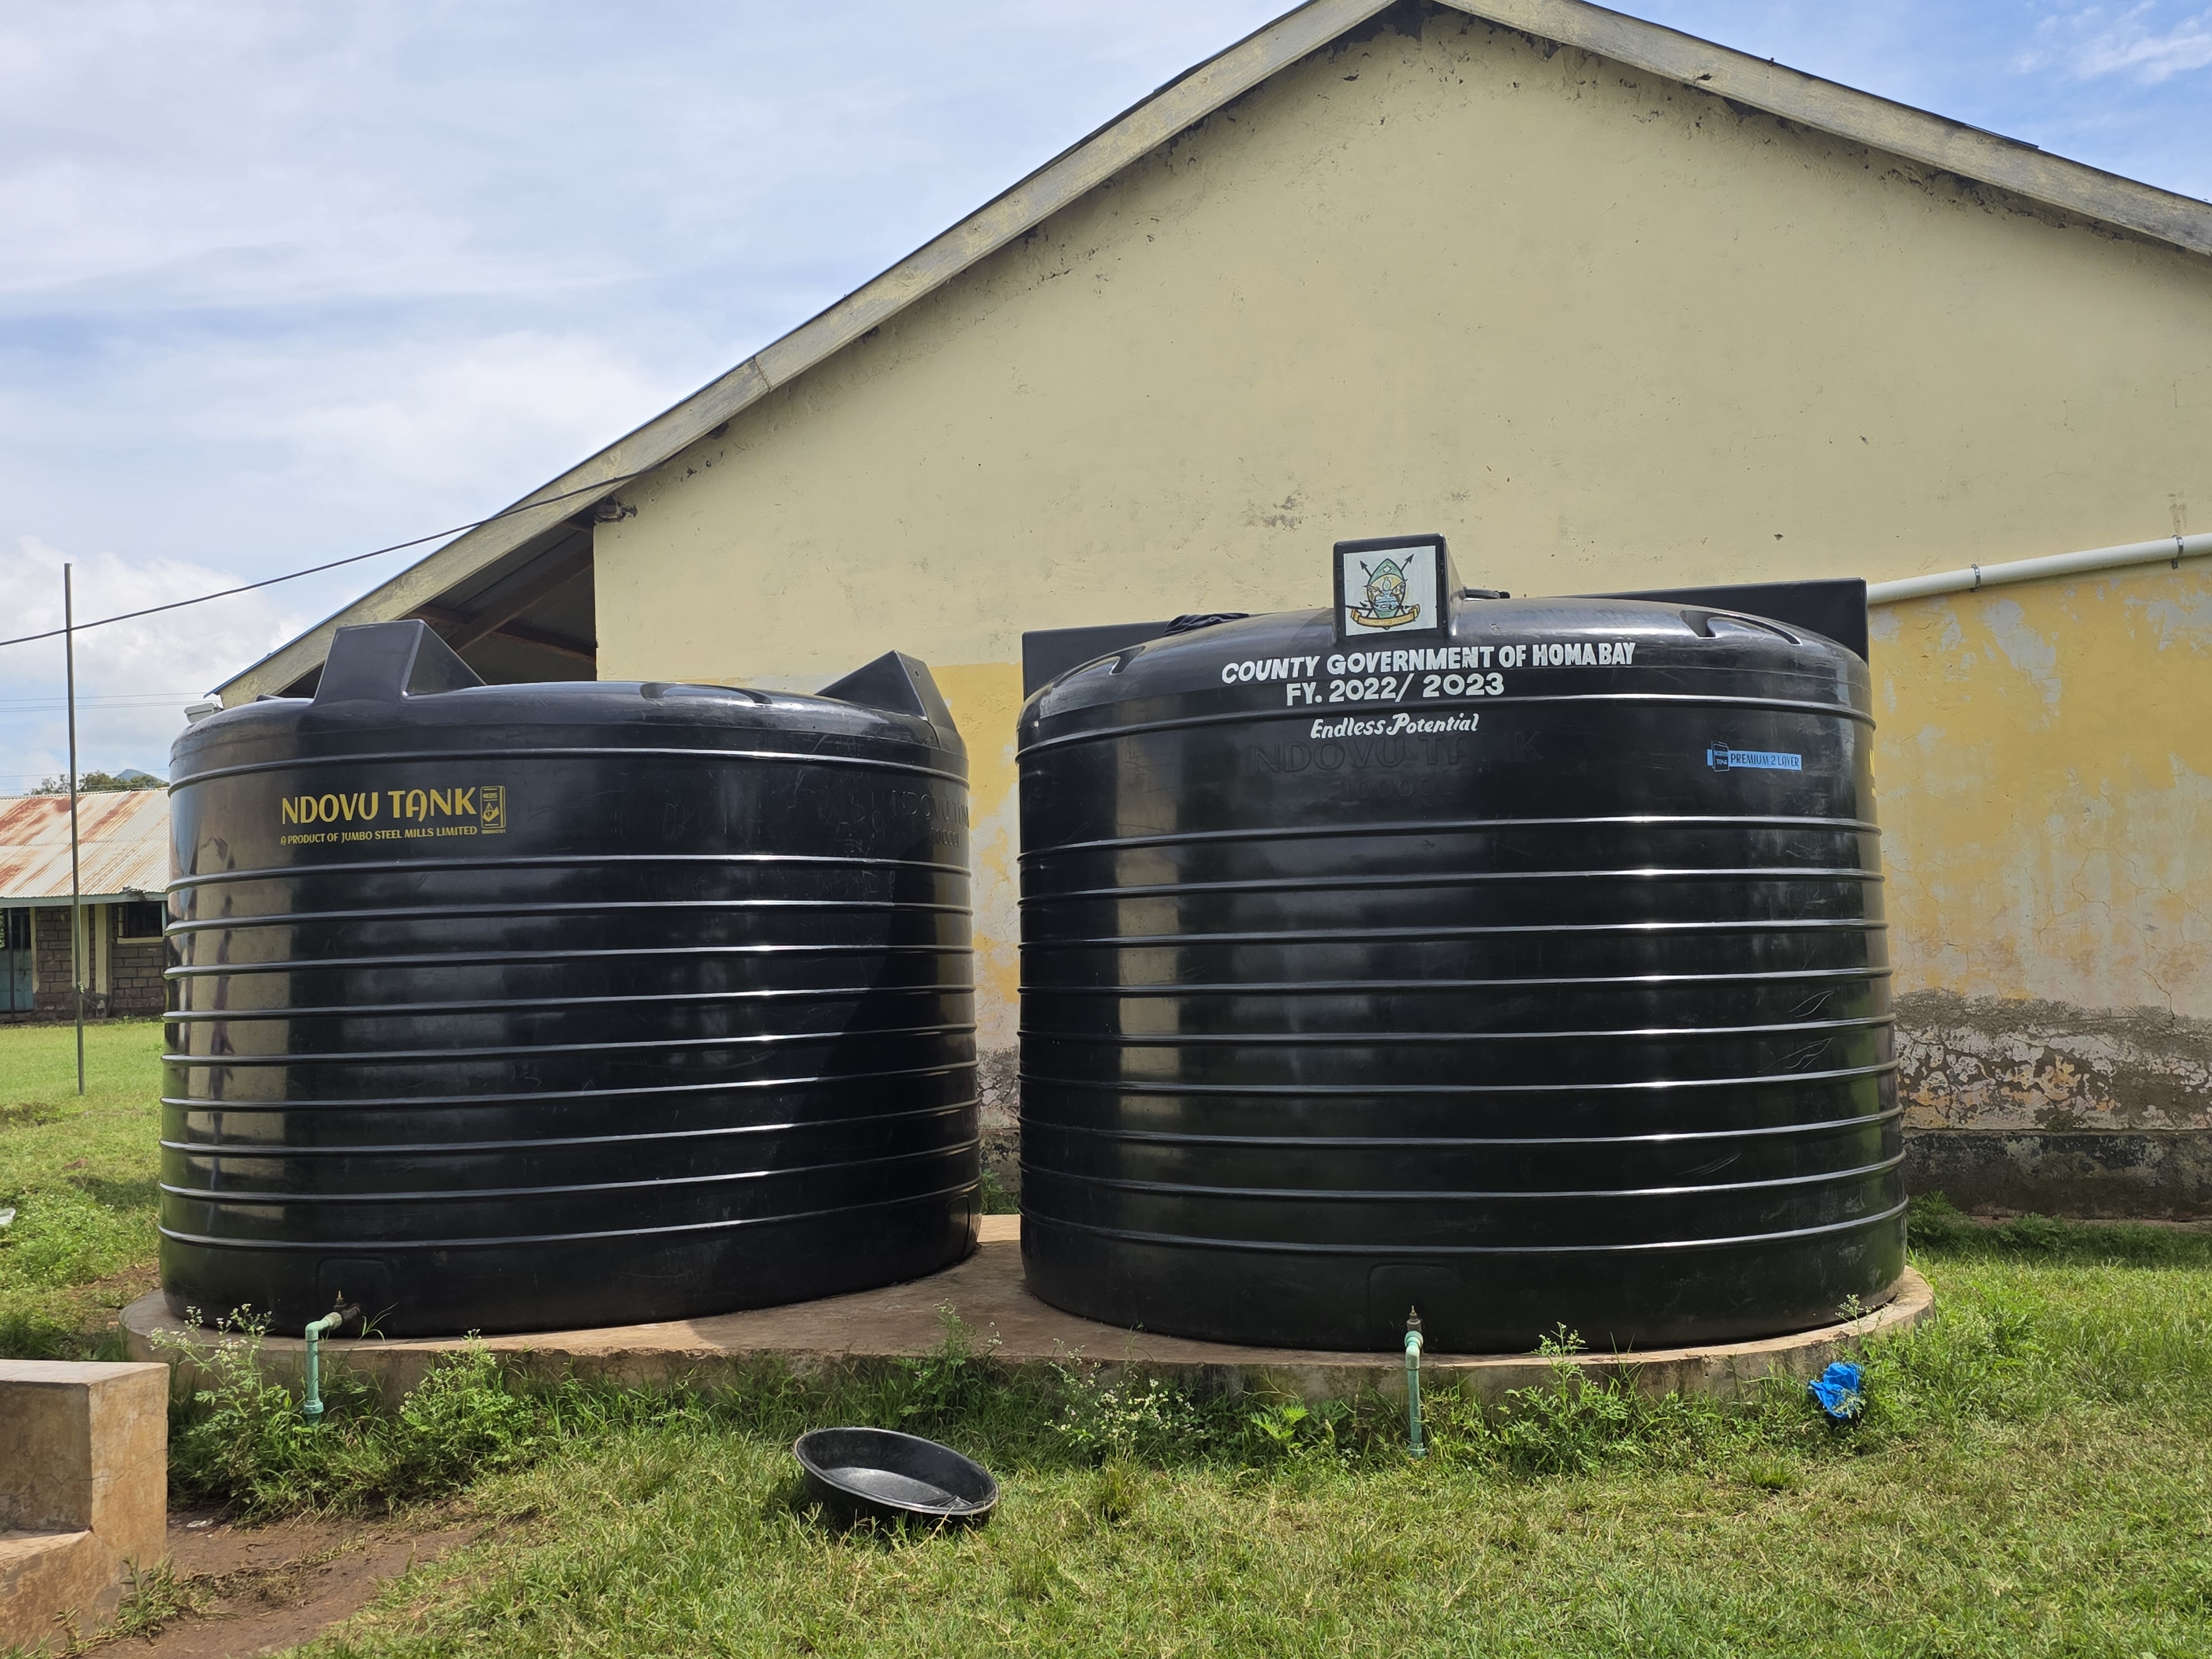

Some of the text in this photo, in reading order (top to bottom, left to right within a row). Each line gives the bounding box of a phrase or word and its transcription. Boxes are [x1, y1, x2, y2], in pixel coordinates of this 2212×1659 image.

[1222, 655, 1321, 684] COUNTY
[1327, 645, 1495, 675] GOVERNMENT
[1499, 644, 1526, 668] OF
[1286, 681, 1323, 706] FY.
[1422, 672, 1505, 698] 2023
[1310, 712, 1479, 739] Endless Potential
[1730, 753, 1769, 765] PREMIUM
[1770, 755, 1776, 765] 2
[1777, 755, 1799, 767] LAYER
[282, 787, 477, 825] NDOVU TANK
[281, 836, 286, 846] A
[288, 833, 326, 844] PRODUCT
[327, 832, 339, 842] OF
[341, 831, 373, 843] JUMBO
[374, 830, 403, 840] STEEL
[404, 828, 434, 838] MILLS
[436, 826, 478, 837] LIMITED
